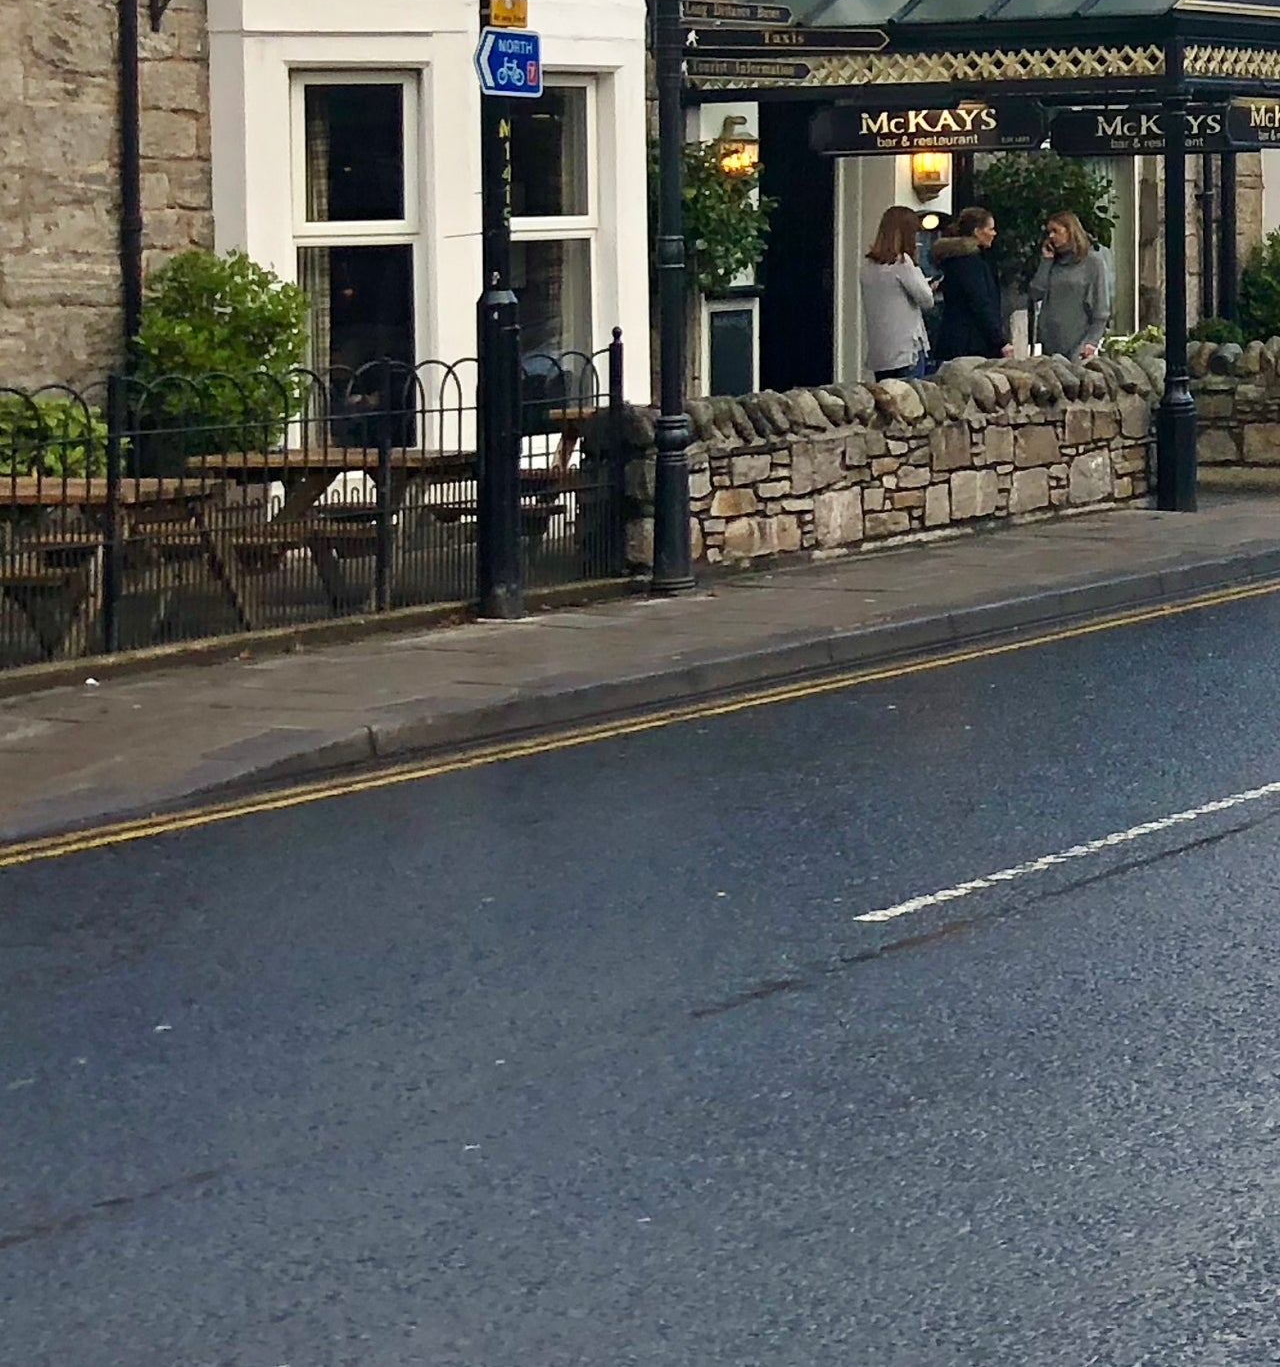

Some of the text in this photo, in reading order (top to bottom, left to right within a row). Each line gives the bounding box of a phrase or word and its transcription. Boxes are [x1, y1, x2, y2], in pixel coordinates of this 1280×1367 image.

[763, 32, 805, 44] Taxis
[498, 38, 534, 54] NORTH
[858, 108, 999, 135] McKAYS
[1096, 114, 1222, 137] McKYS
[877, 134, 979, 148] bar & restaurant
[1111, 138, 1129, 149] bar
[1132, 137, 1141, 148] &
